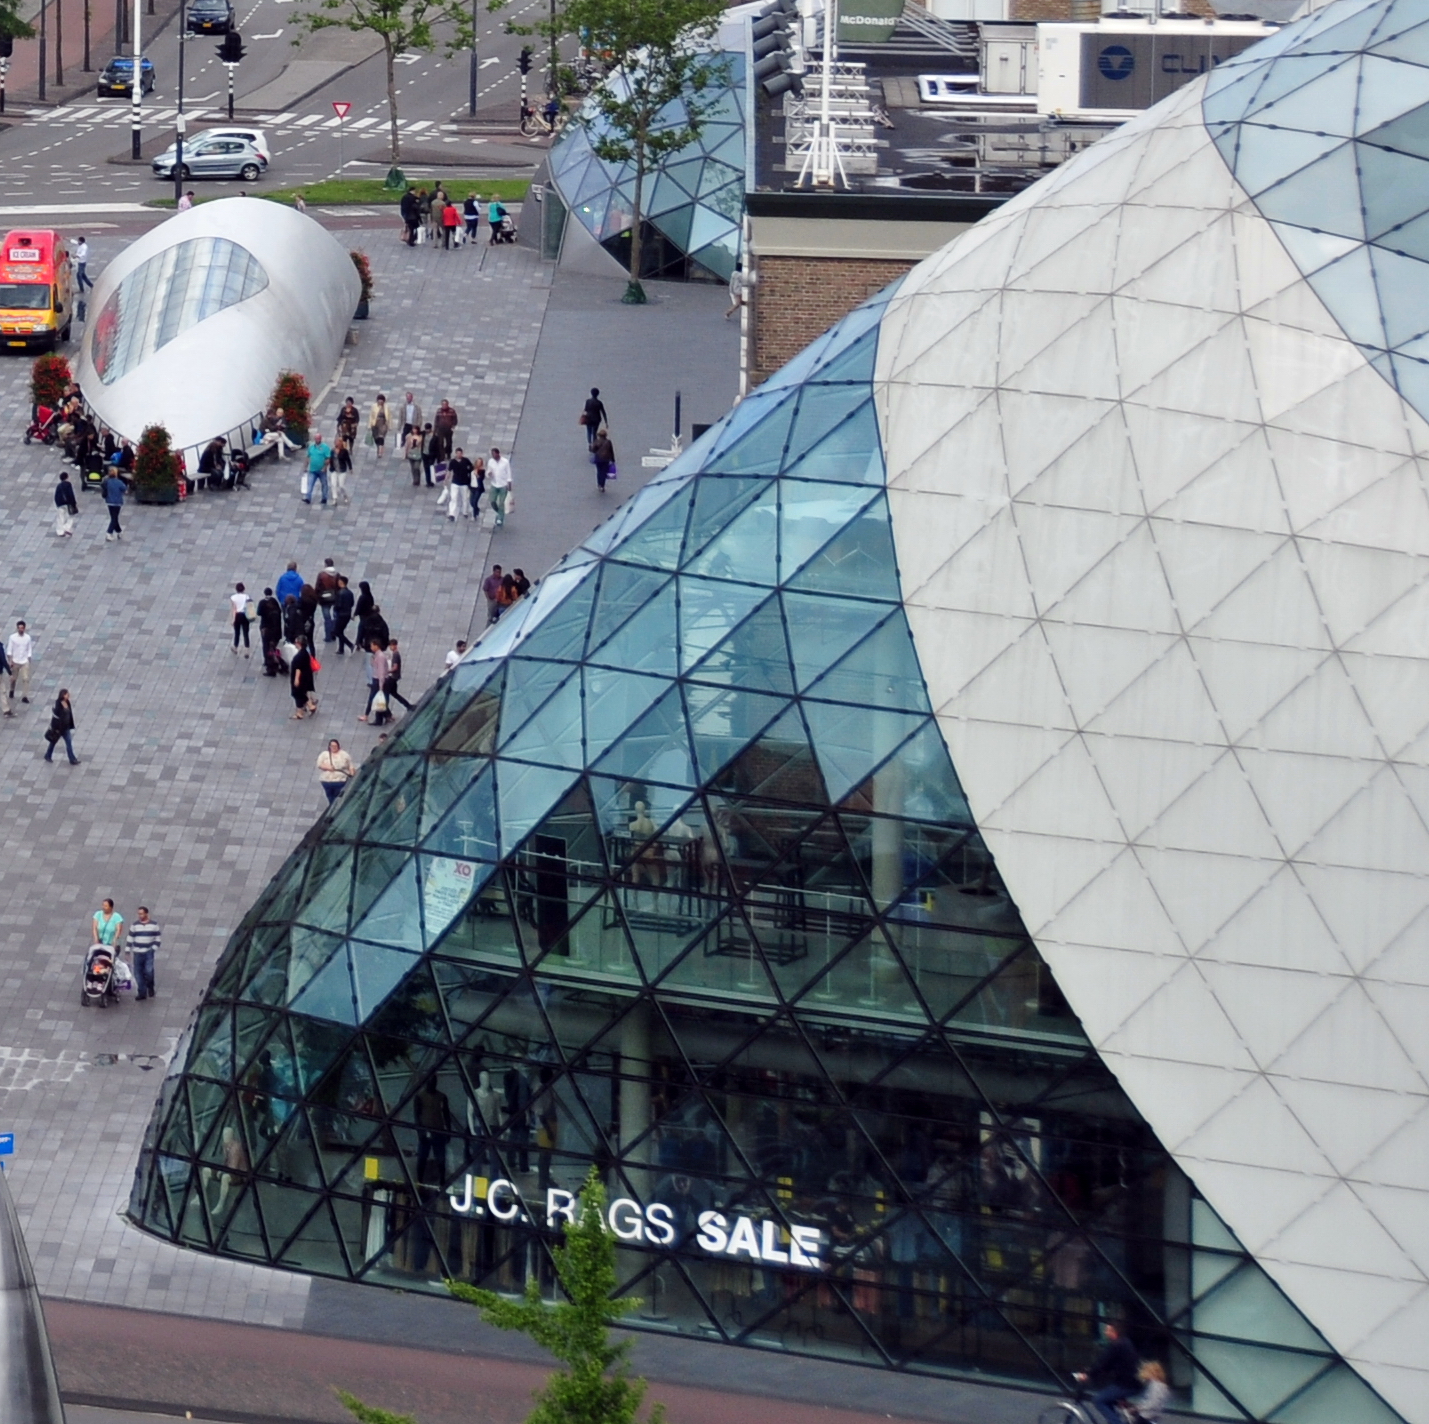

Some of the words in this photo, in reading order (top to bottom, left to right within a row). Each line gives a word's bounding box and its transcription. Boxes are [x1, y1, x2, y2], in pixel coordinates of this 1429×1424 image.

[454, 862, 471, 876] XO
[449, 1173, 528, 1224] J.C.
[696, 1210, 821, 1268] SALE
